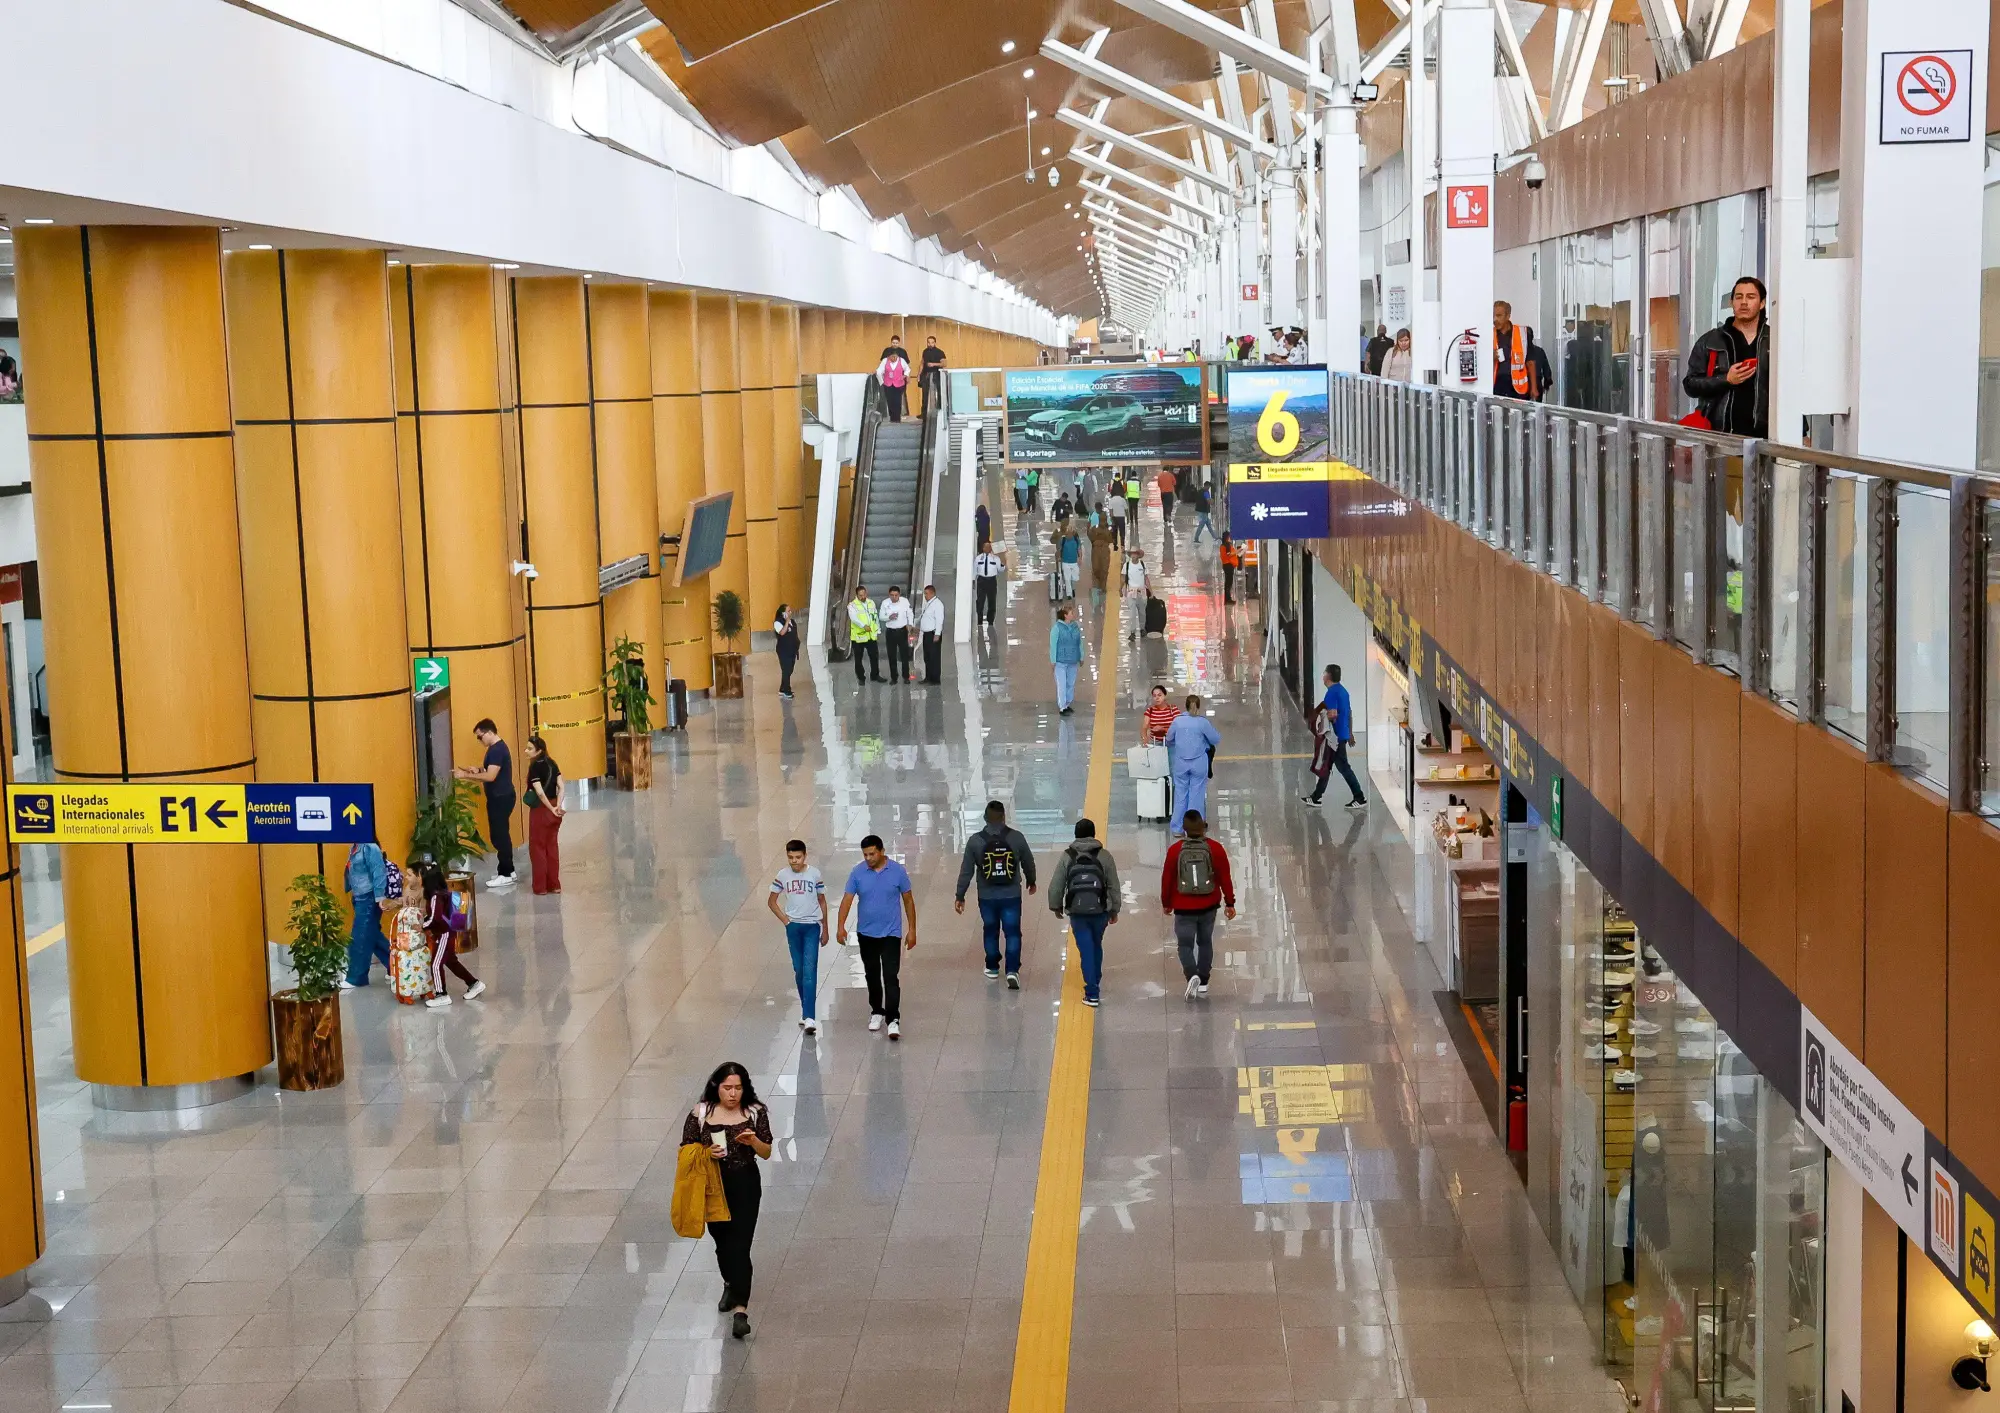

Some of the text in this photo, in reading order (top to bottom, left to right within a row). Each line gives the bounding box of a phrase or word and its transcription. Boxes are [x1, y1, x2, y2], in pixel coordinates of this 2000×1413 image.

[1900, 126, 1950, 135] NO FUMAR
[1257, 390, 1300, 458] 6
[1026, 450, 1056, 458] Sportage
[62, 794, 108, 808] Llegadas
[247, 802, 290, 812] Aerotrén
[62, 809, 144, 819] Internacionales
[160, 796, 197, 832] E1
[254, 816, 291, 824] Aerotrain
[63, 823, 154, 834] International arrivals
[1830, 1055, 1895, 1135] Abordaje por Circuito Interior
[1830, 1076, 1840, 1101] Blvd.
[1842, 1088, 1856, 1117] Puerto
[1830, 1098, 1846, 1134] Boarding
[1847, 1120, 1862, 1150] through
[1863, 1135, 1878, 1165] Circuito
[1935, 1236, 1954, 1264] METRO
